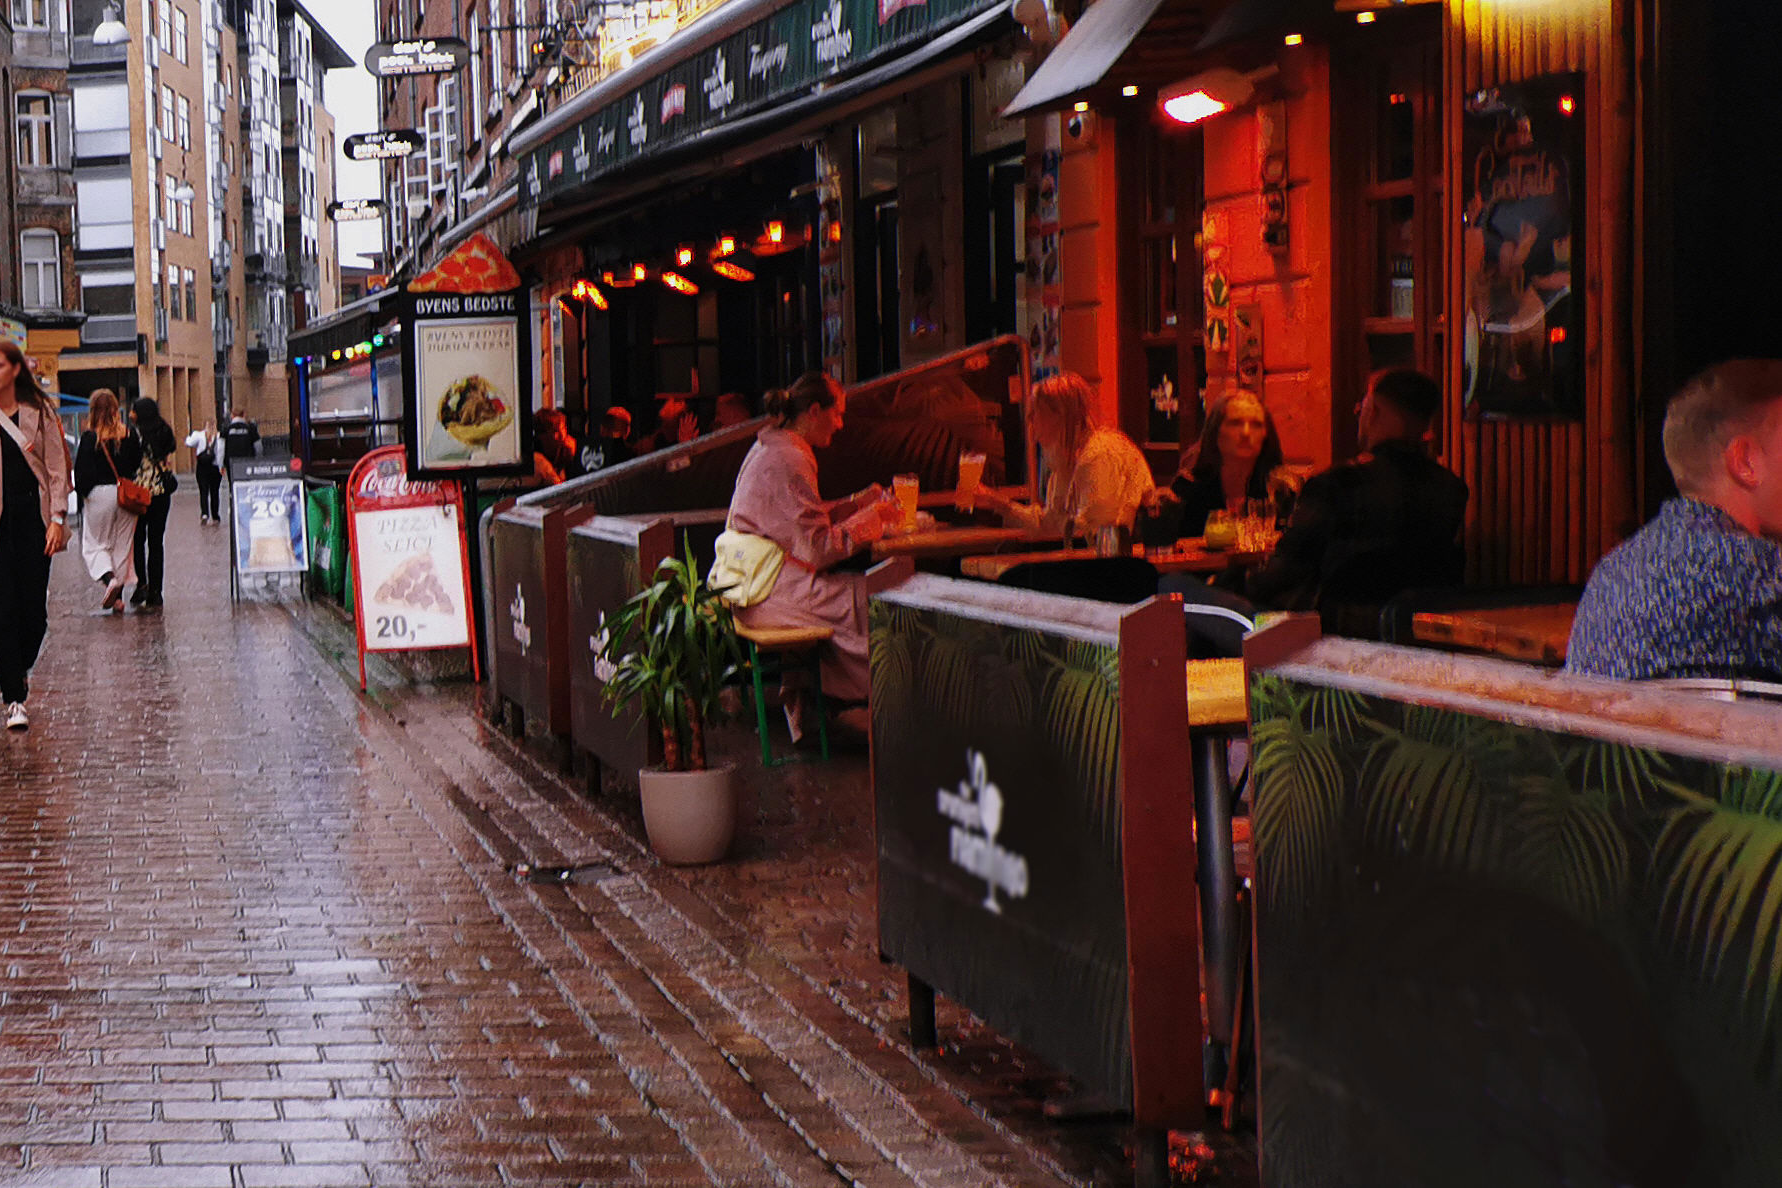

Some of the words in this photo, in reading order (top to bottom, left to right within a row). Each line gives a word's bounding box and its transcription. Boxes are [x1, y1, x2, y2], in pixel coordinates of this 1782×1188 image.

[416, 298, 460, 315] BYENS
[464, 295, 515, 312] BEDSTE
[378, 517, 437, 535] PIZZA
[376, 614, 427, 641] 20,-
